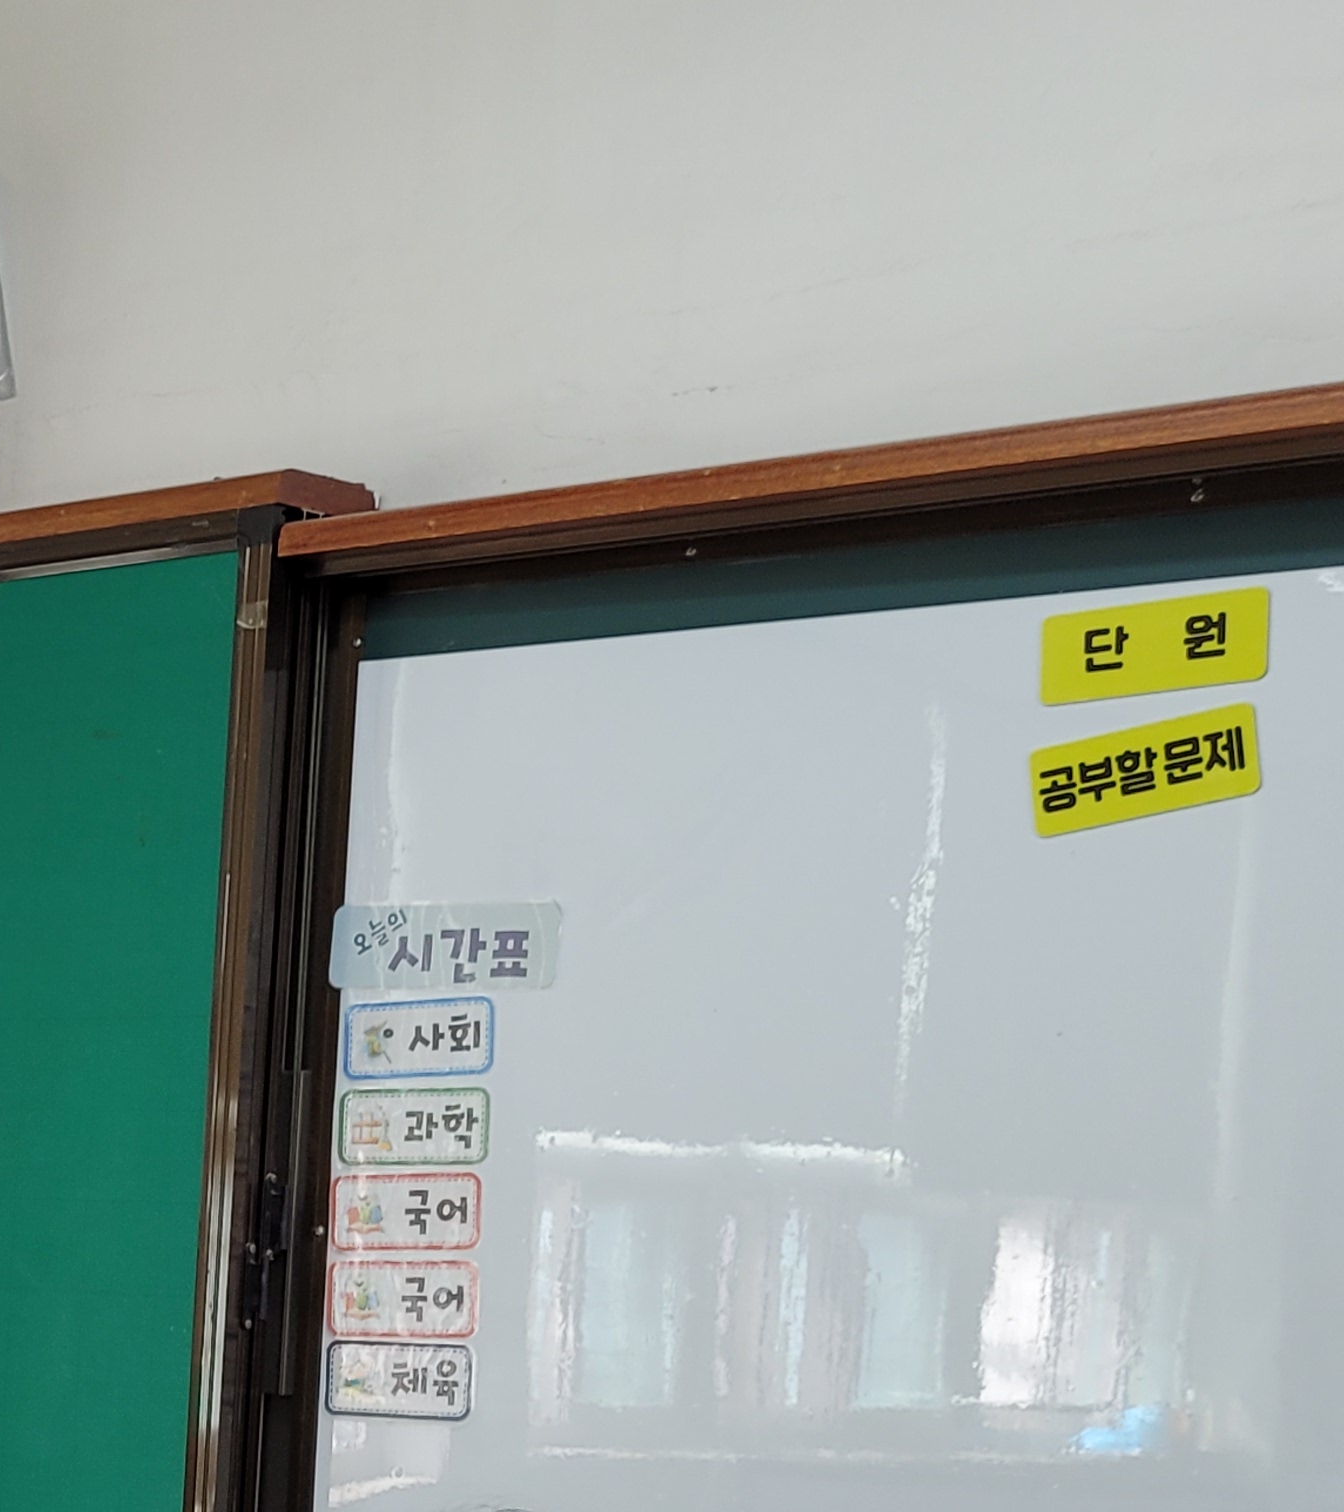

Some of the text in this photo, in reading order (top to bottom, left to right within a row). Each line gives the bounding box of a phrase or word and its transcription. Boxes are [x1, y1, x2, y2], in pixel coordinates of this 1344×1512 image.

[353, 909, 408, 956] 오늘의
[388, 927, 530, 984] 시간표
[408, 1013, 482, 1053] 사회
[404, 1104, 479, 1150] 과학
[405, 1190, 468, 1235] 국어
[401, 1277, 465, 1322] 국어
[391, 1360, 460, 1406] 체육
